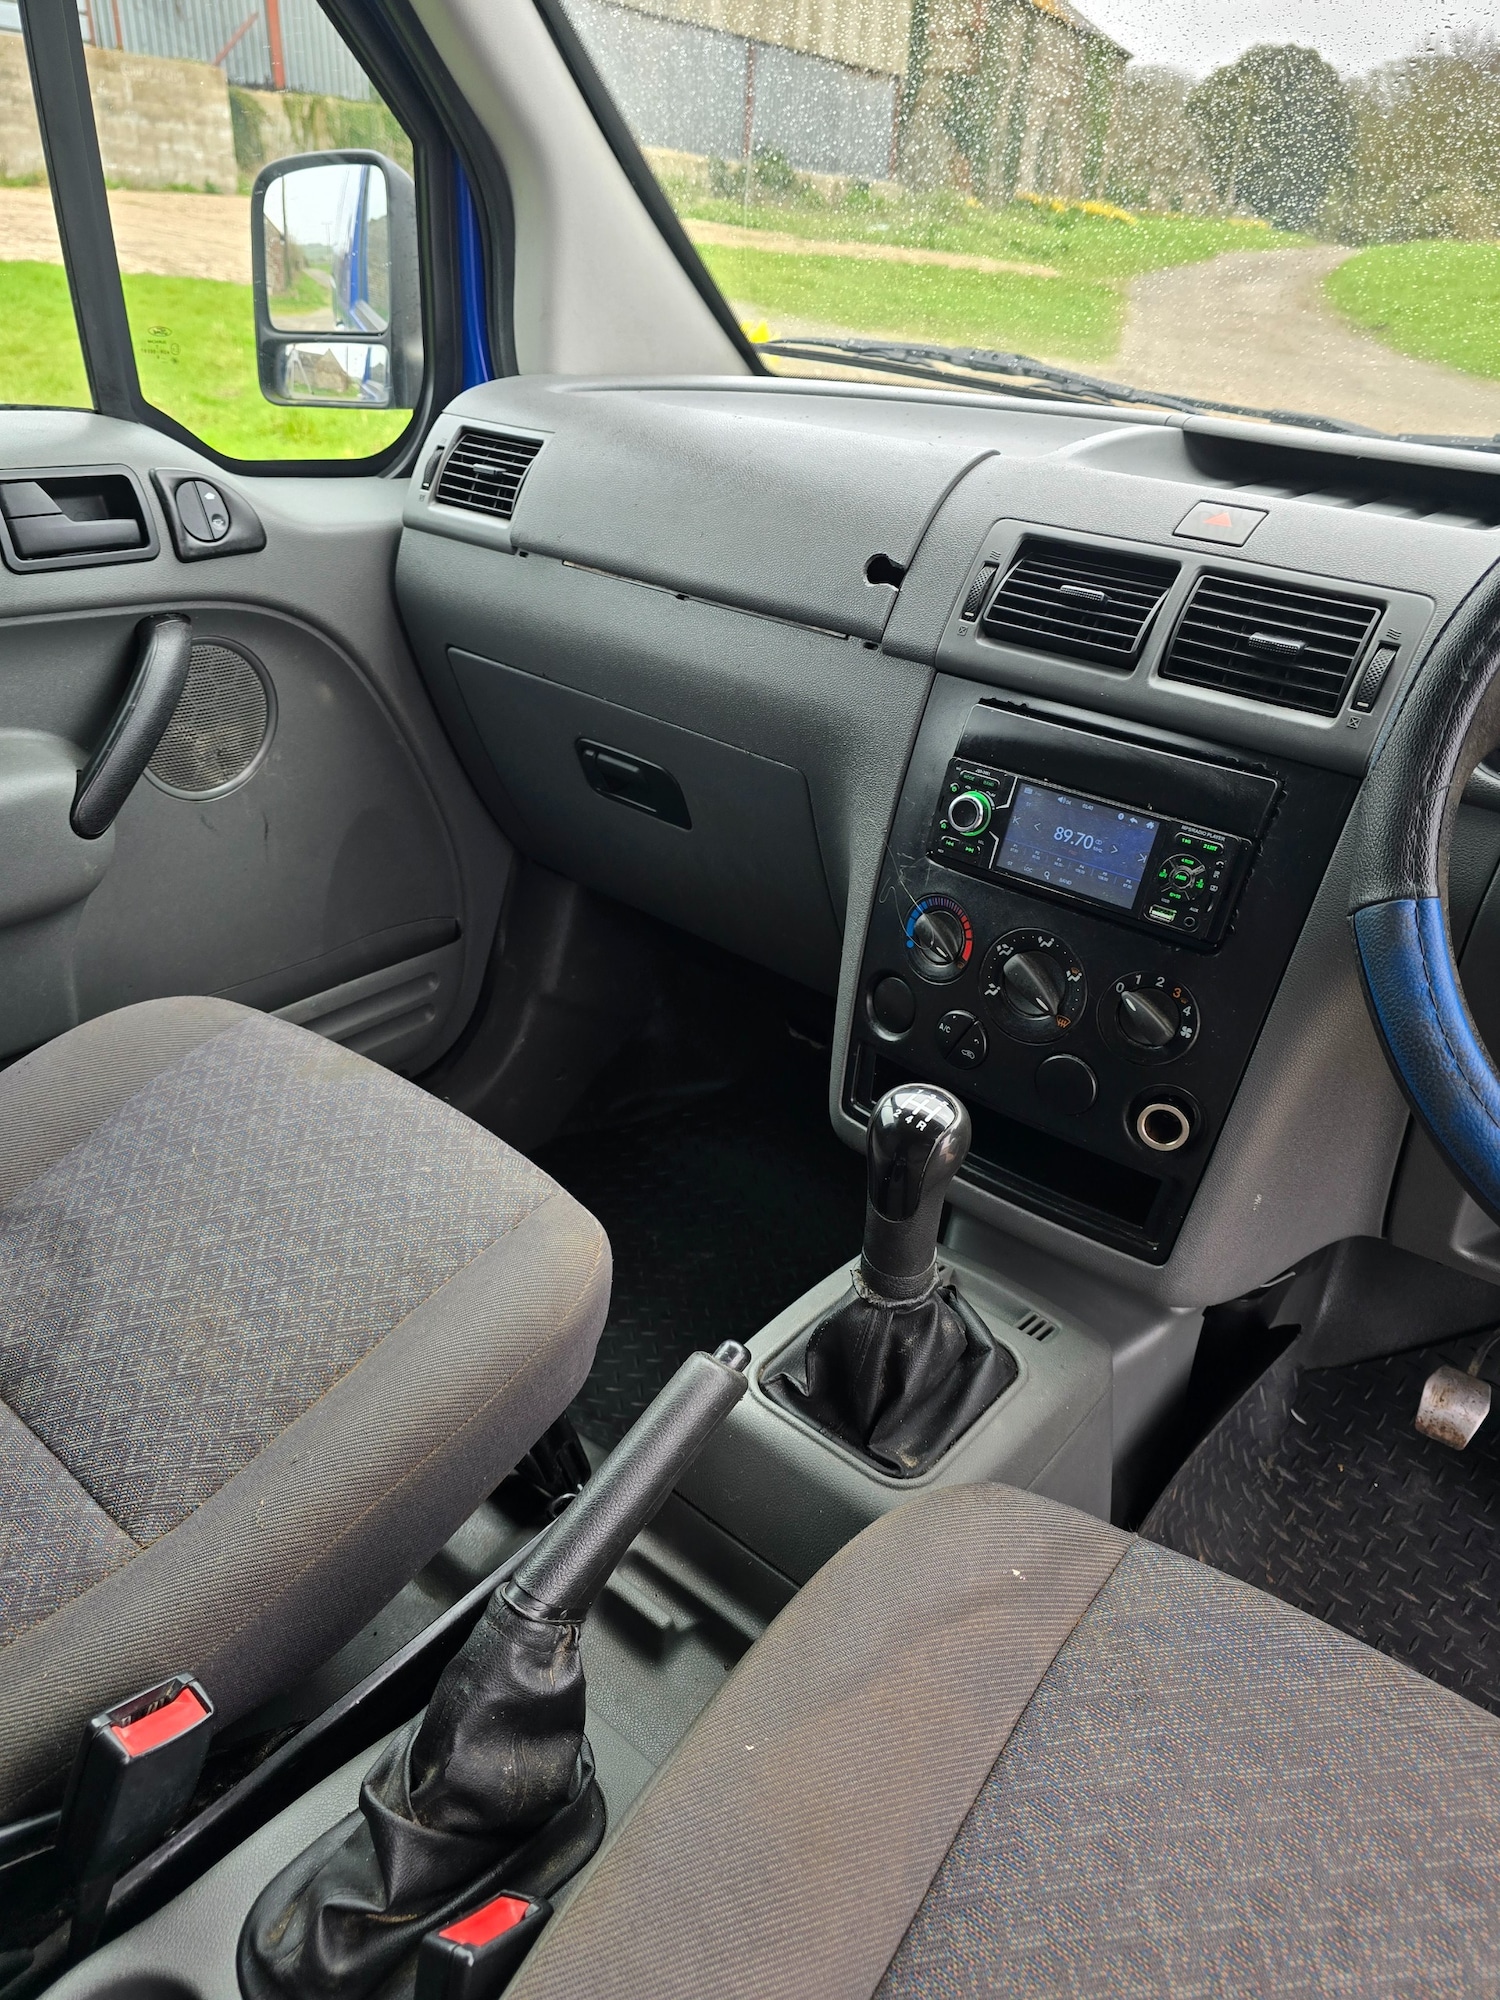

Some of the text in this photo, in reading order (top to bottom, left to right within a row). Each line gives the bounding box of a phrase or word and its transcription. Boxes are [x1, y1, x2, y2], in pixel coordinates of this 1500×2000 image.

[1054, 826, 1094, 850] 89.70
[1207, 832, 1226, 841] PLAYER
[1059, 878, 1072, 886] BAND
[1116, 975, 1191, 1016] 0 1 2 3 4
[939, 1023, 951, 1033] A/C
[893, 1109, 927, 1131] 2 4 R
